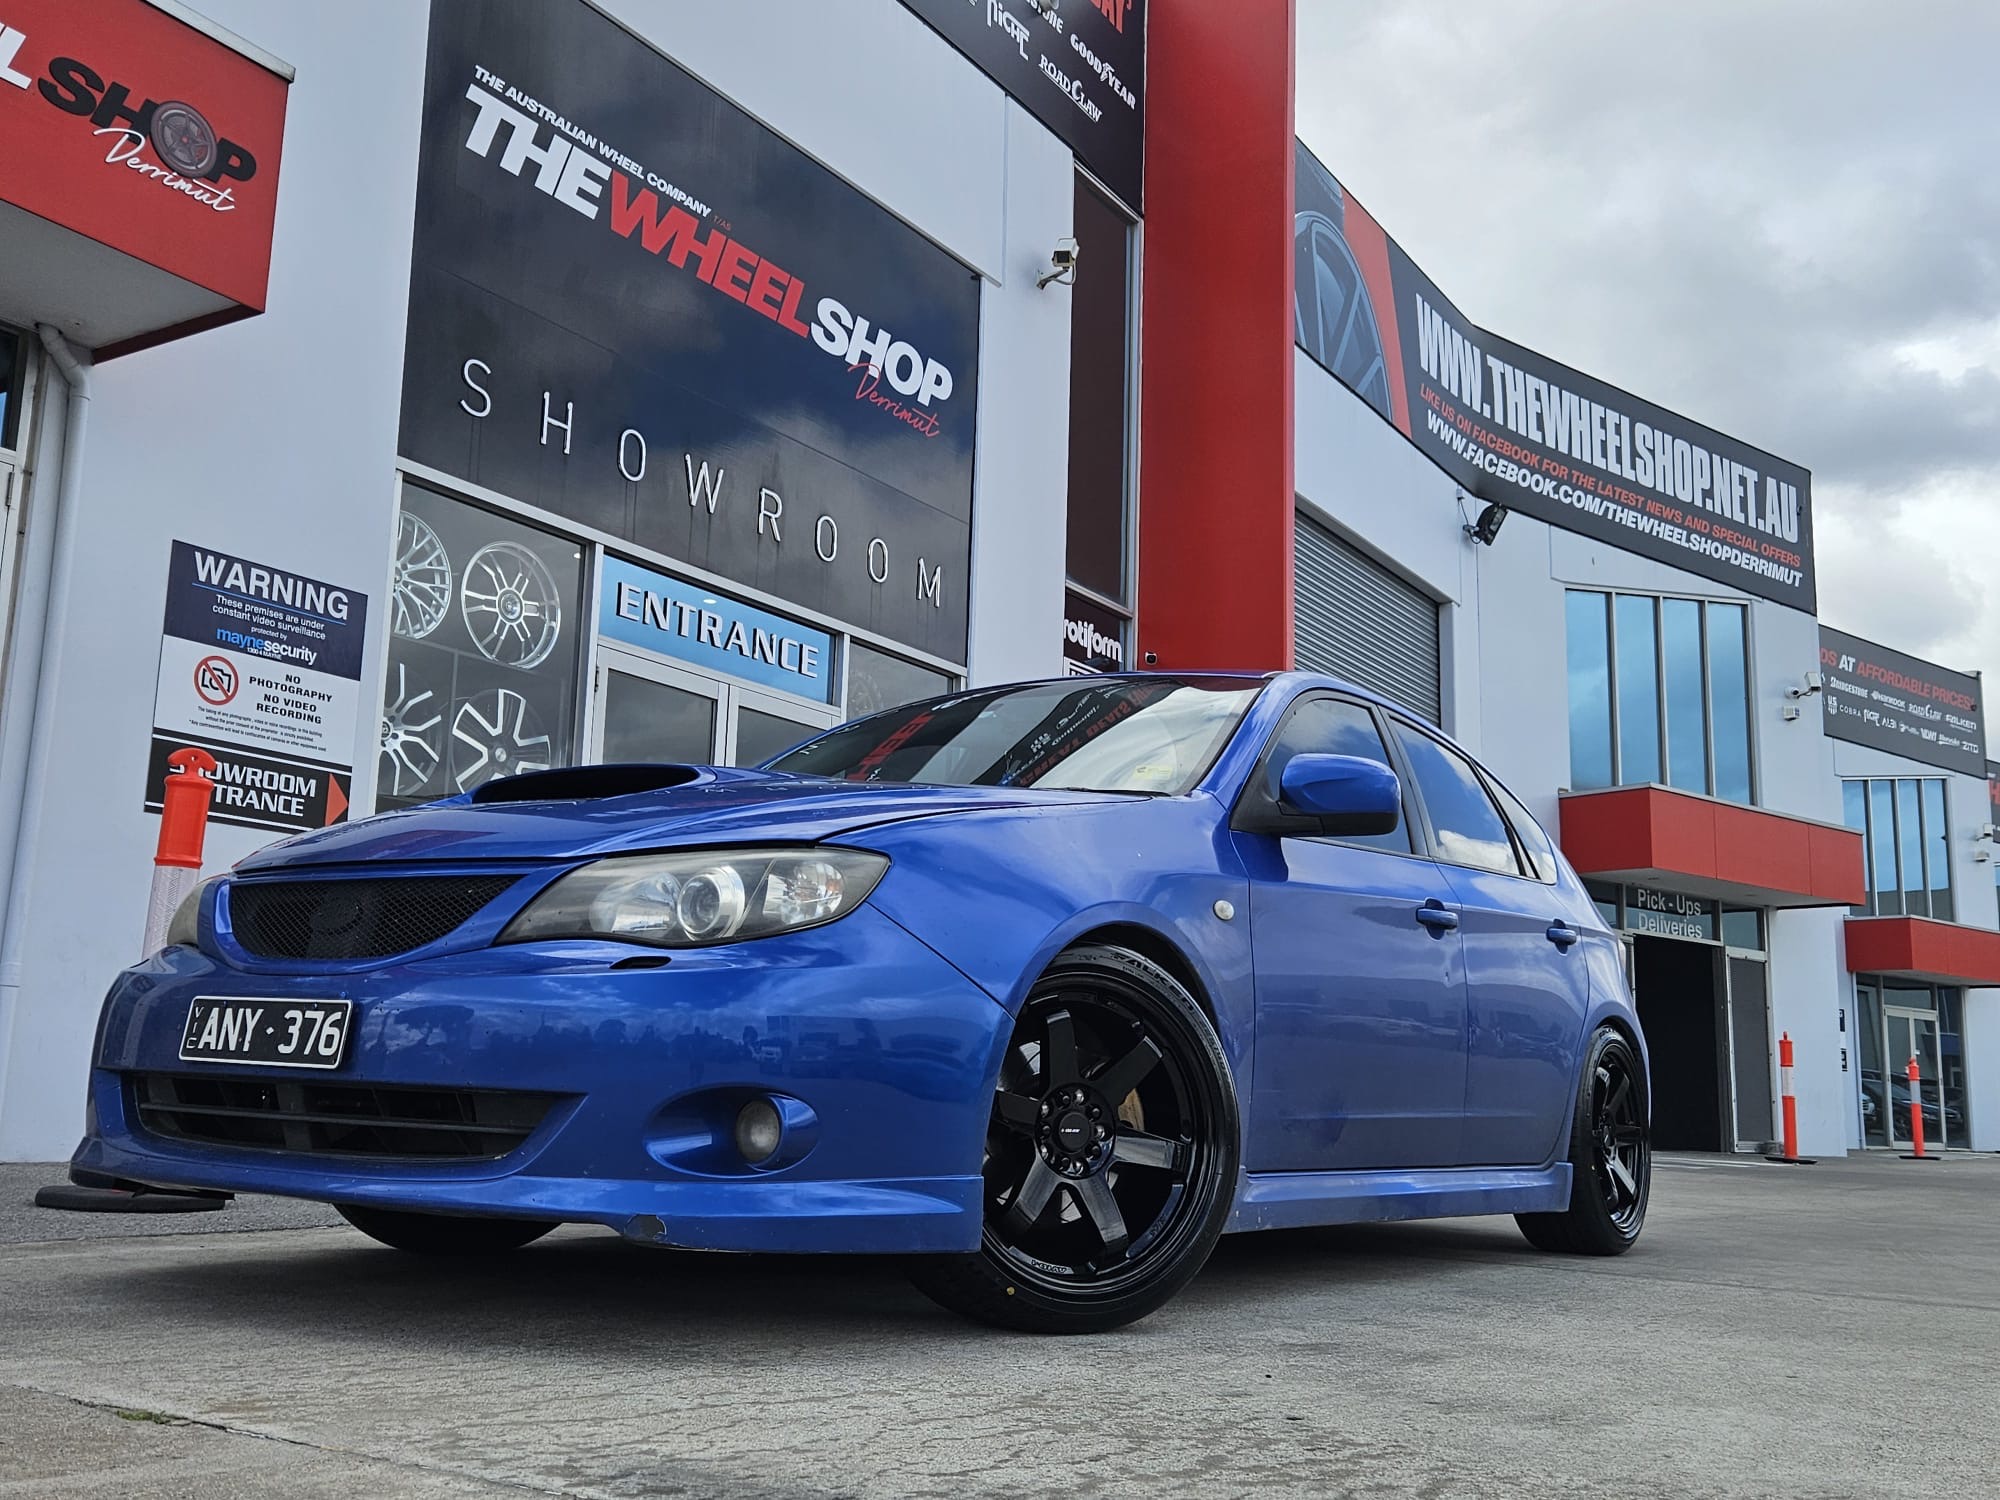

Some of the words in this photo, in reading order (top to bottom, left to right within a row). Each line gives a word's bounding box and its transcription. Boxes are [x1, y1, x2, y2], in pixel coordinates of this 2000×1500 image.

[0, 22, 32, 90] L
[1070, 33, 1136, 110] GOODYEAR
[475, 64, 505, 92] THE
[505, 86, 597, 149] AUSTRALIAN
[599, 142, 645, 180] WHEEL
[646, 172, 712, 217] COMPANY
[93, 127, 235, 212] Derrimut
[847, 363, 940, 437] Derrimut
[460, 359, 942, 608] SHOWROOM
[1420, 383, 1441, 409] LIKE
[1441, 401, 1455, 420] US
[1456, 413, 1472, 435] ON
[1473, 425, 1540, 469] FACEBOOK
[1541, 458, 1568, 480] FOR
[1571, 470, 1595, 490] THE
[1597, 480, 1645, 508] LATEST
[1646, 500, 1683, 524] NEWS
[1685, 515, 1710, 534] AND
[1712, 526, 1759, 553] SPECIAL
[1761, 543, 1801, 568] OFFERS
[1427, 409, 1803, 588] WWW.FACEBOOK.COM/THEWHEELSHOPDERRIMUT
[194, 551, 349, 620] WARNING
[212, 605, 250, 621] constant
[252, 614, 275, 627] video
[277, 621, 326, 640] surveillance
[216, 594, 243, 609] These
[244, 603, 284, 620] premises
[285, 614, 299, 624] are
[300, 617, 325, 630] under
[251, 626, 279, 638] protected
[279, 631, 288, 641] by
[617, 580, 819, 679] ENTRANCE
[1064, 618, 1123, 662] rotiform
[249, 676, 333, 703] PHOTOGRAPHY
[285, 673, 301, 684] NO
[1839, 654, 1856, 672] AT
[1856, 660, 1931, 698] AFFORDABLE
[256, 703, 322, 724] RECORDING
[263, 693, 280, 706] NO
[284, 697, 317, 713] VIDEO
[1637, 889, 1666, 911] Pick
[1676, 894, 1701, 918] Ups
[1638, 913, 1702, 939] Deliveries
[197, 1008, 264, 1052] ANY
[277, 1010, 342, 1056] 376
